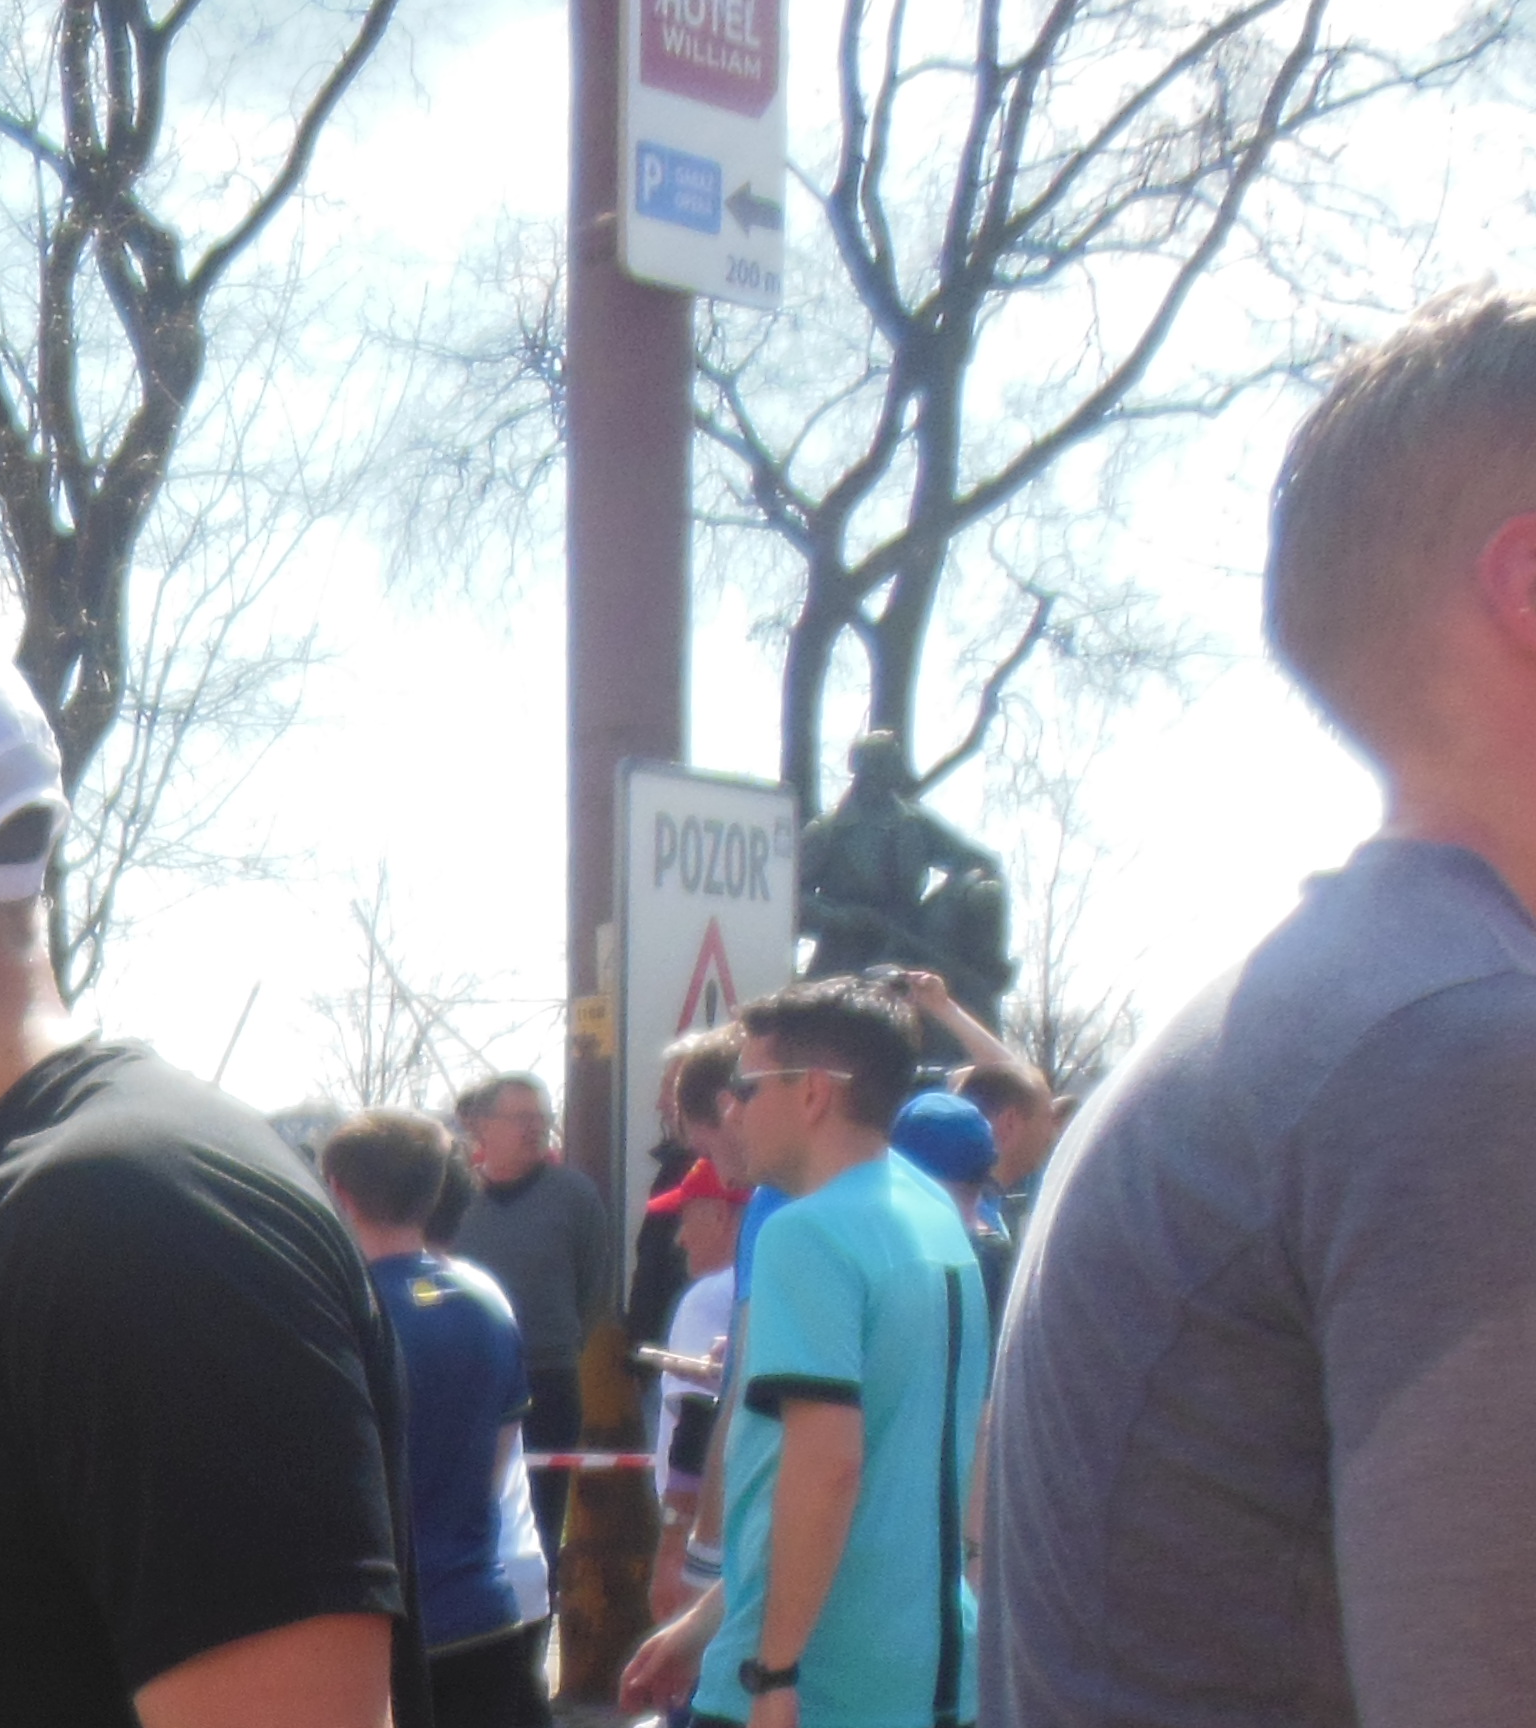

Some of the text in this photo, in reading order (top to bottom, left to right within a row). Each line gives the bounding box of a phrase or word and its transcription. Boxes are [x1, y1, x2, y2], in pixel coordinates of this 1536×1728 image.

[662, 21, 761, 80] WILLIAM
[642, 152, 663, 203] P
[725, 253, 760, 288] 200
[654, 809, 771, 902] POZOR
